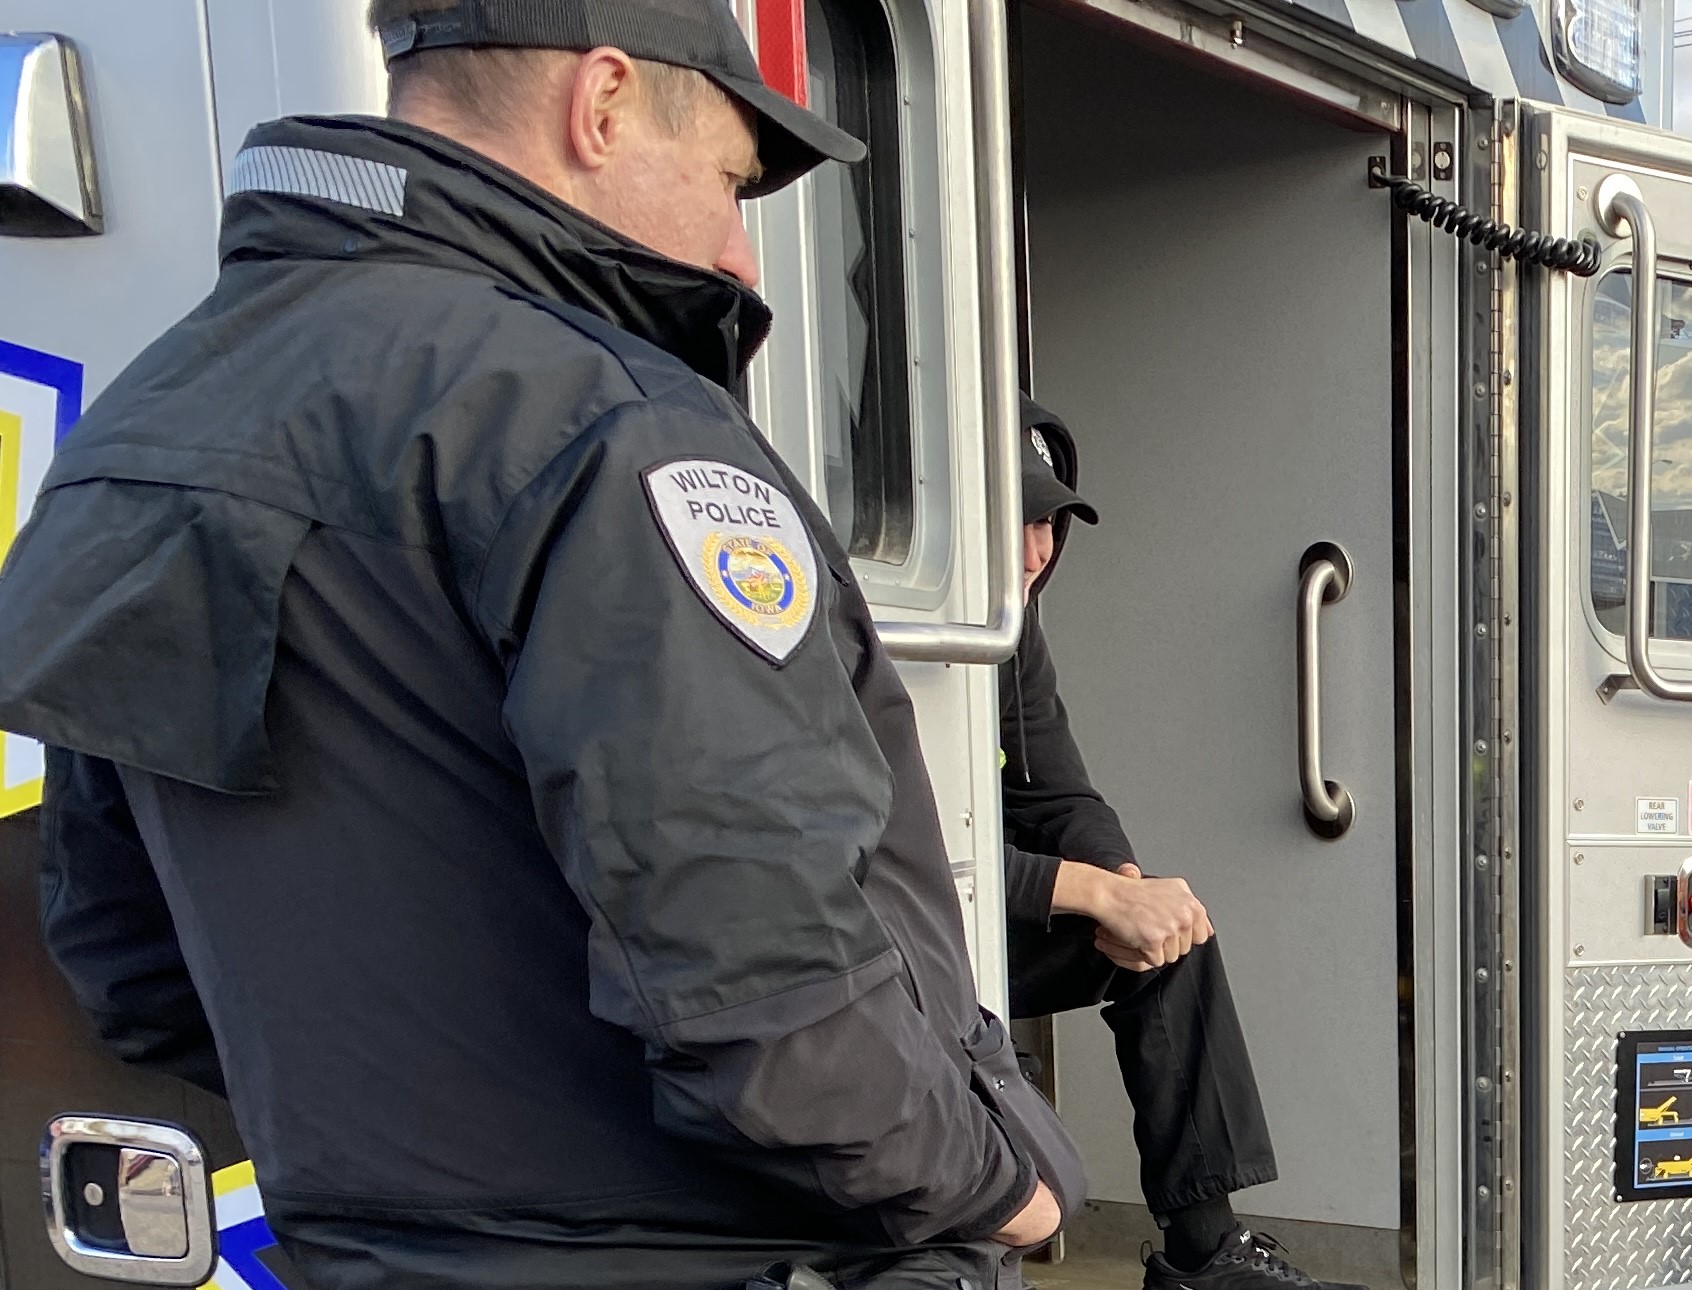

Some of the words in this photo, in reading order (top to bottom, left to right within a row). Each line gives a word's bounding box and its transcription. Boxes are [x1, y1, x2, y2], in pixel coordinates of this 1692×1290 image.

[670, 468, 771, 505] WILTON
[686, 500, 782, 529] POLICE
[1648, 801, 1665, 809] REAR
[1640, 811, 1674, 821] LOWERING
[1647, 822, 1666, 831] VALVE
